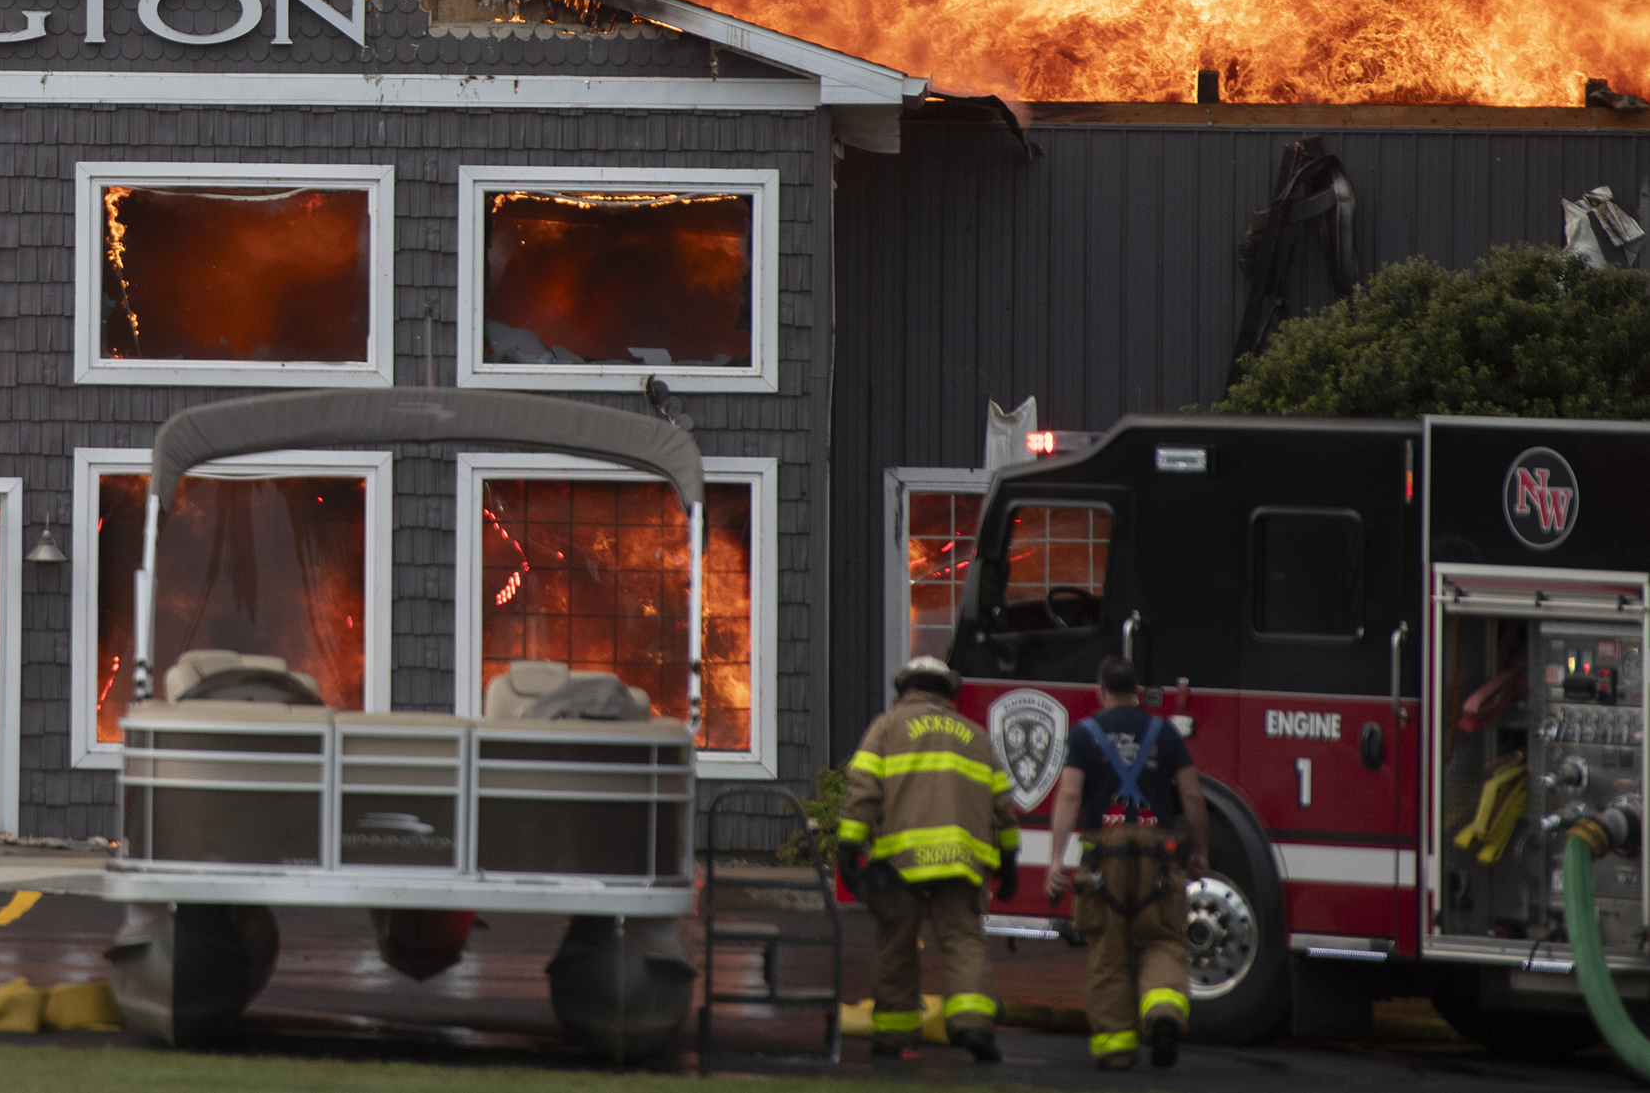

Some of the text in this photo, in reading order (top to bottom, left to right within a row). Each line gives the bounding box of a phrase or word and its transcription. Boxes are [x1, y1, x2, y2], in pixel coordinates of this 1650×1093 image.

[1514, 467, 1574, 531] NW
[906, 715, 974, 746] JACKSON
[1265, 709, 1342, 741] ENGINE
[1294, 757, 1312, 809] 1
